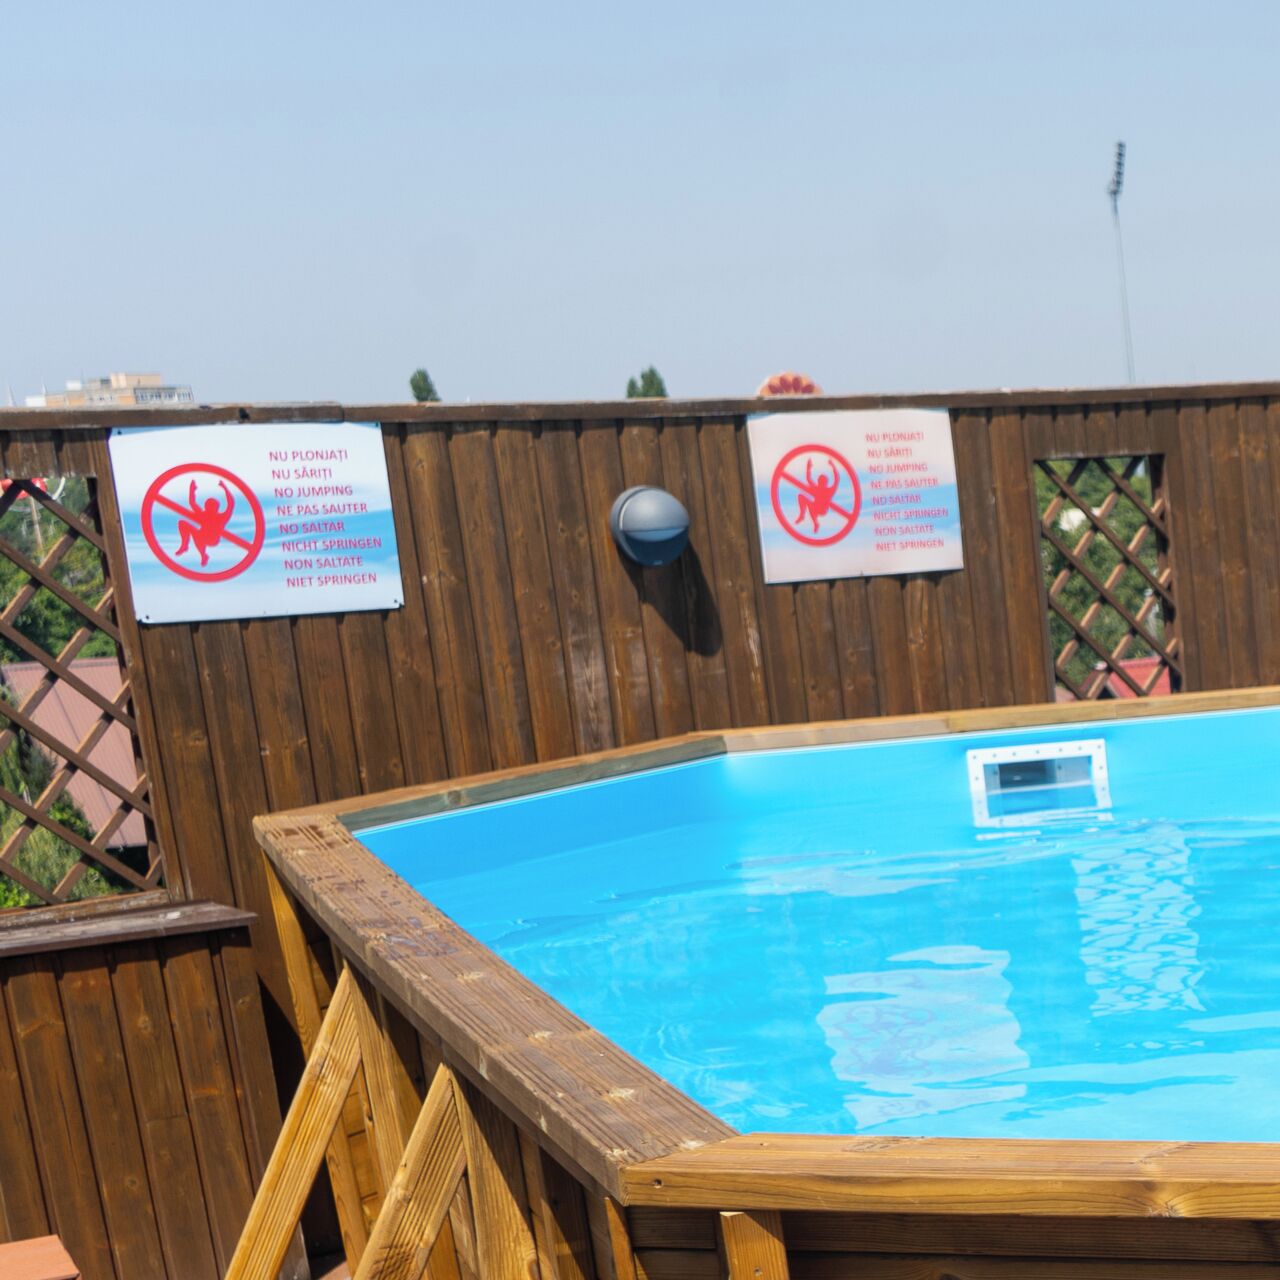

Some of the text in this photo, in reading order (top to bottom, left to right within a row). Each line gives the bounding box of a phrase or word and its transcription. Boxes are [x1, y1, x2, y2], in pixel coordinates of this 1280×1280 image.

[270, 451, 287, 461] NU
[272, 469, 290, 480] NU
[274, 486, 353, 498] NO JUMPING
[277, 503, 367, 516] NE PAS SAUTER
[280, 522, 344, 534] NO SALTAR
[282, 537, 381, 552] NICHT SPRINGEN
[284, 556, 363, 570] NON SALTATE
[287, 573, 377, 587] NIET SPRINGEN
